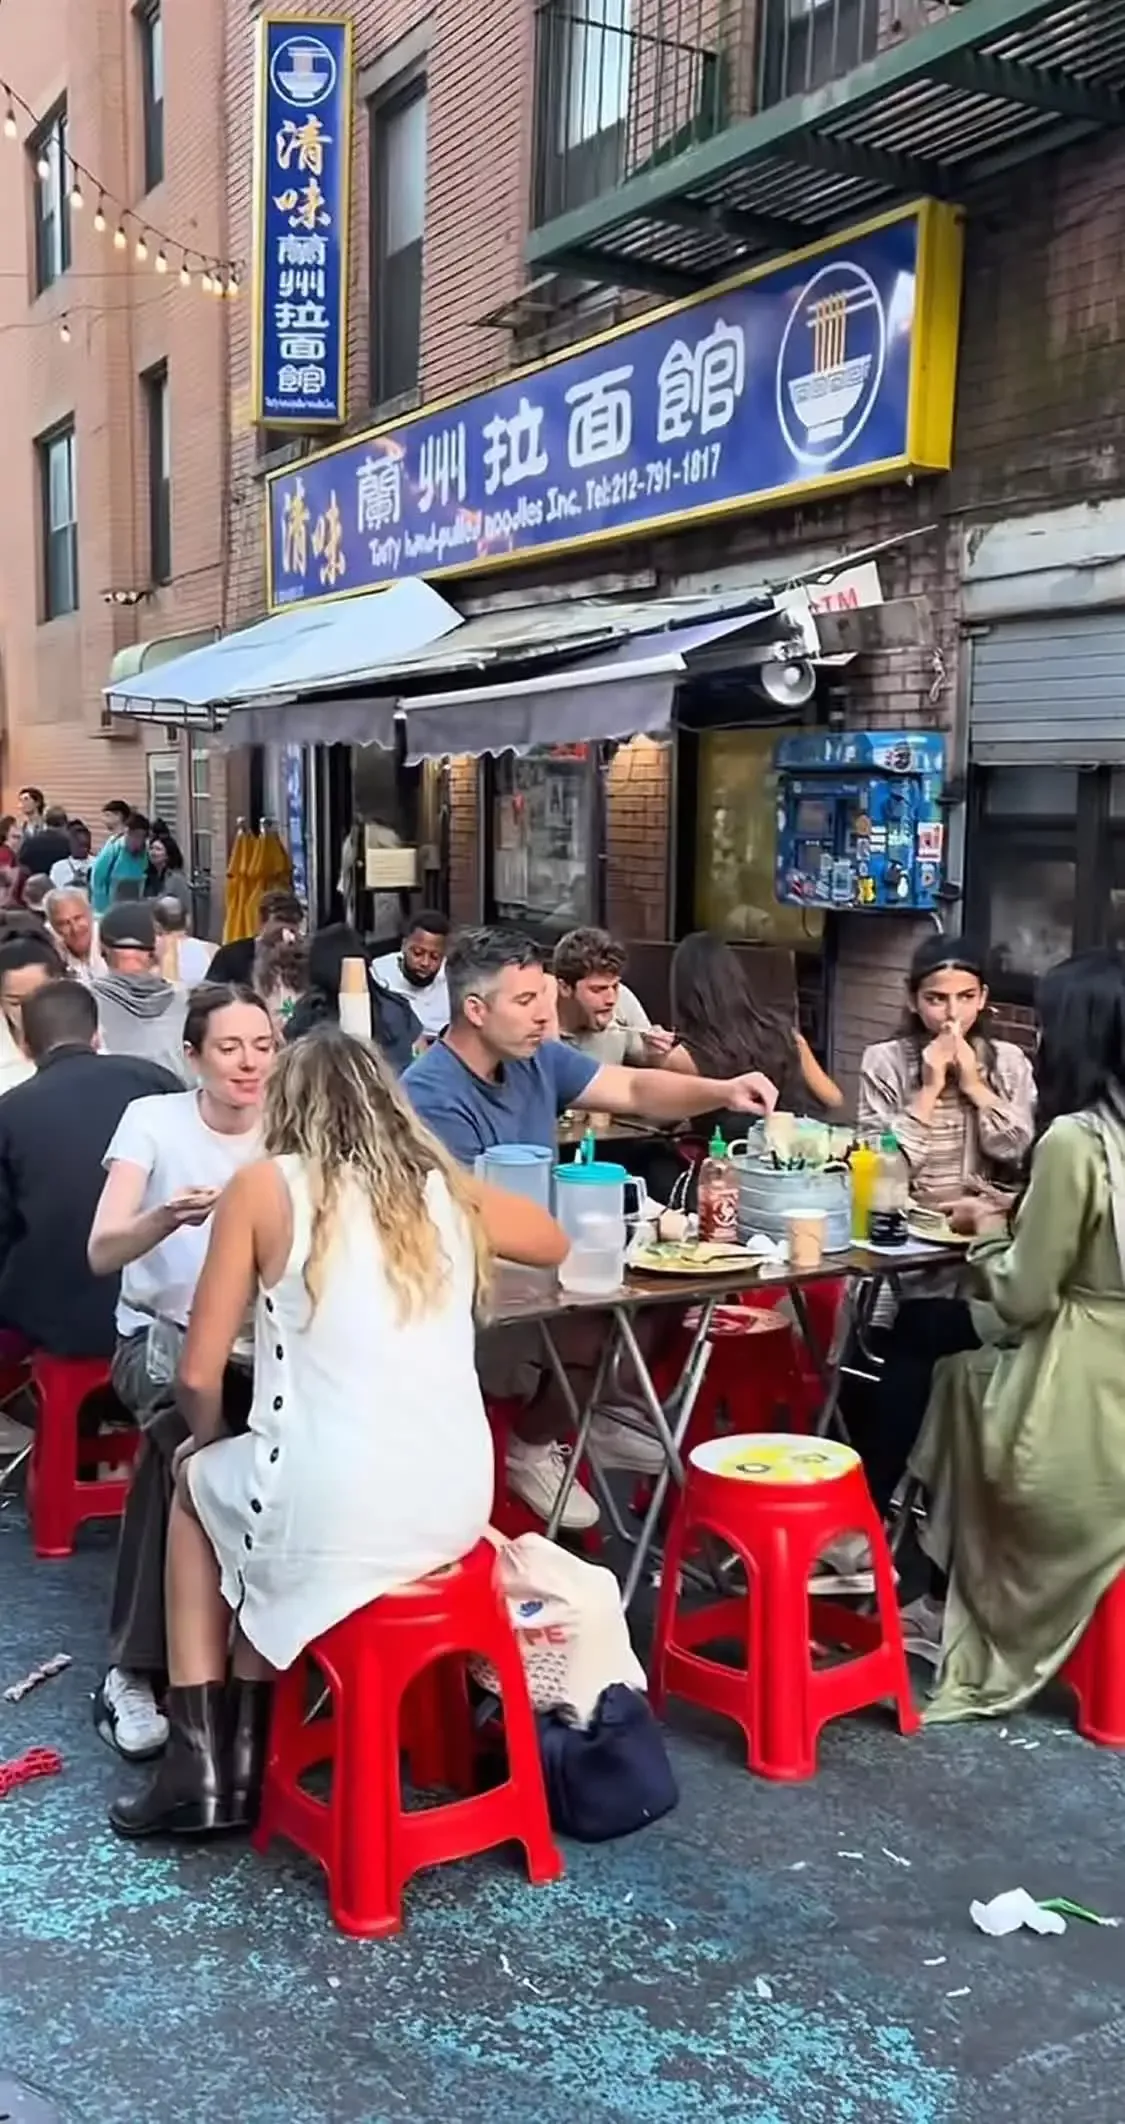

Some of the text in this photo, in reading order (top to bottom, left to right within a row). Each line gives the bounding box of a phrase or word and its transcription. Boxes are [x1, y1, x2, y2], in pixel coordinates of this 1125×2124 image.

[484, 496, 543, 537] noodles
[546, 487, 582, 522] Inc.
[516, 1624, 568, 1646] PE
